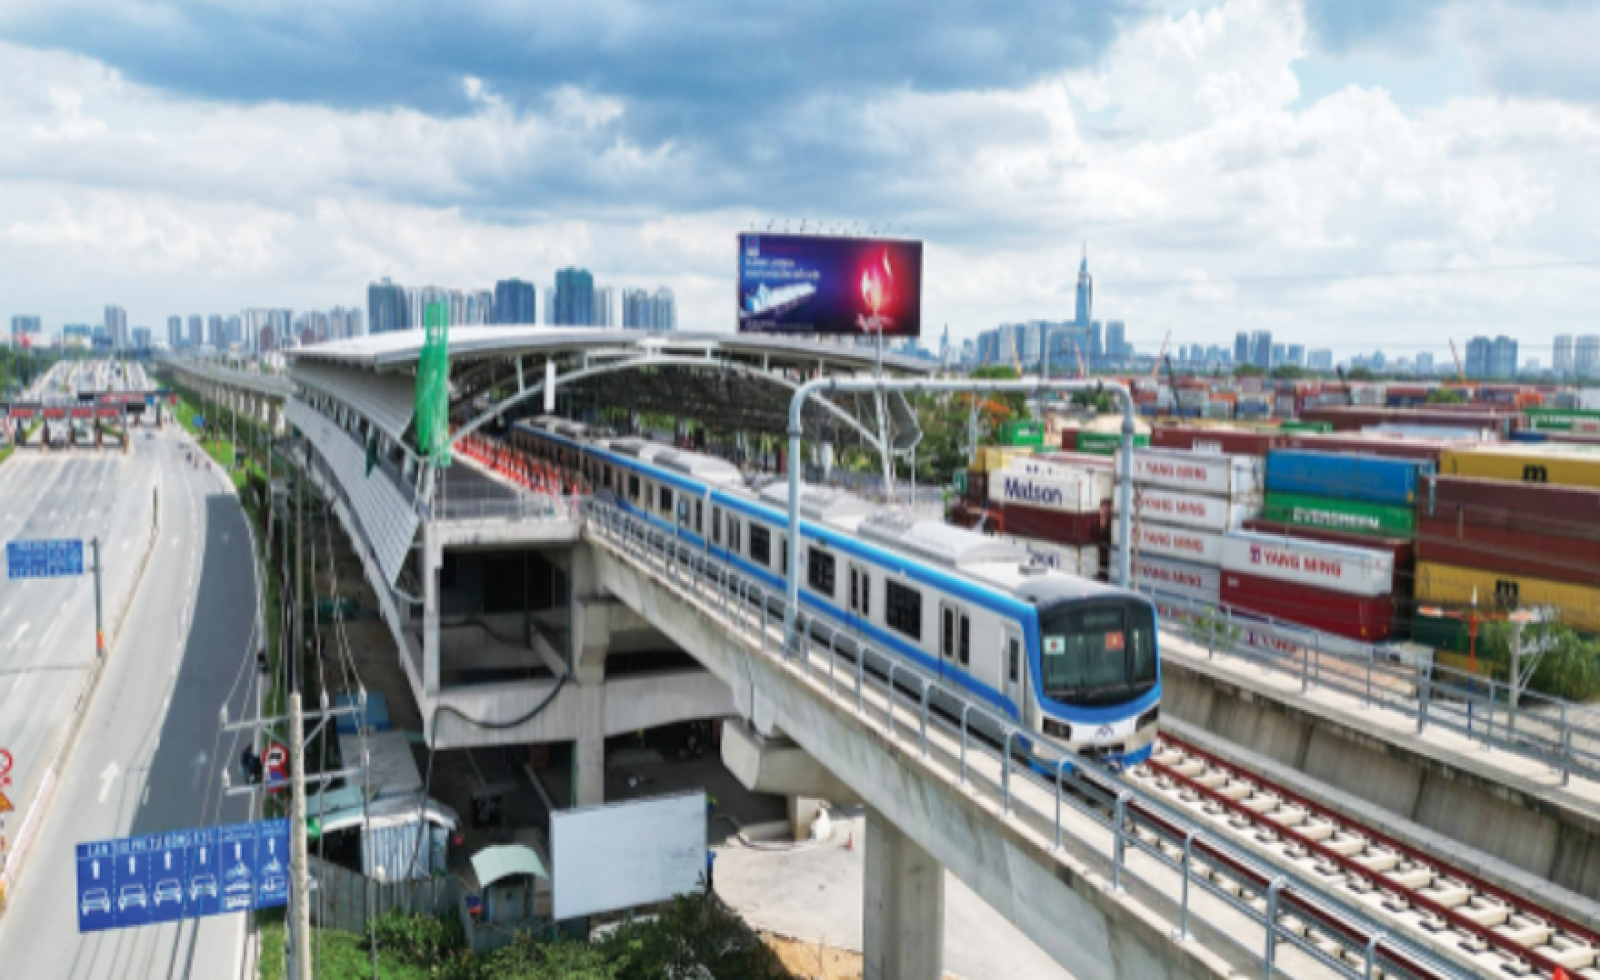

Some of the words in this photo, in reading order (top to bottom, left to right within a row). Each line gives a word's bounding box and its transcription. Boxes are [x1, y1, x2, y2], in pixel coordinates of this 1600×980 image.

[1004, 477, 1062, 506] Matson
[1293, 506, 1379, 530] EVERGREEN
[1263, 548, 1300, 569] YANG
